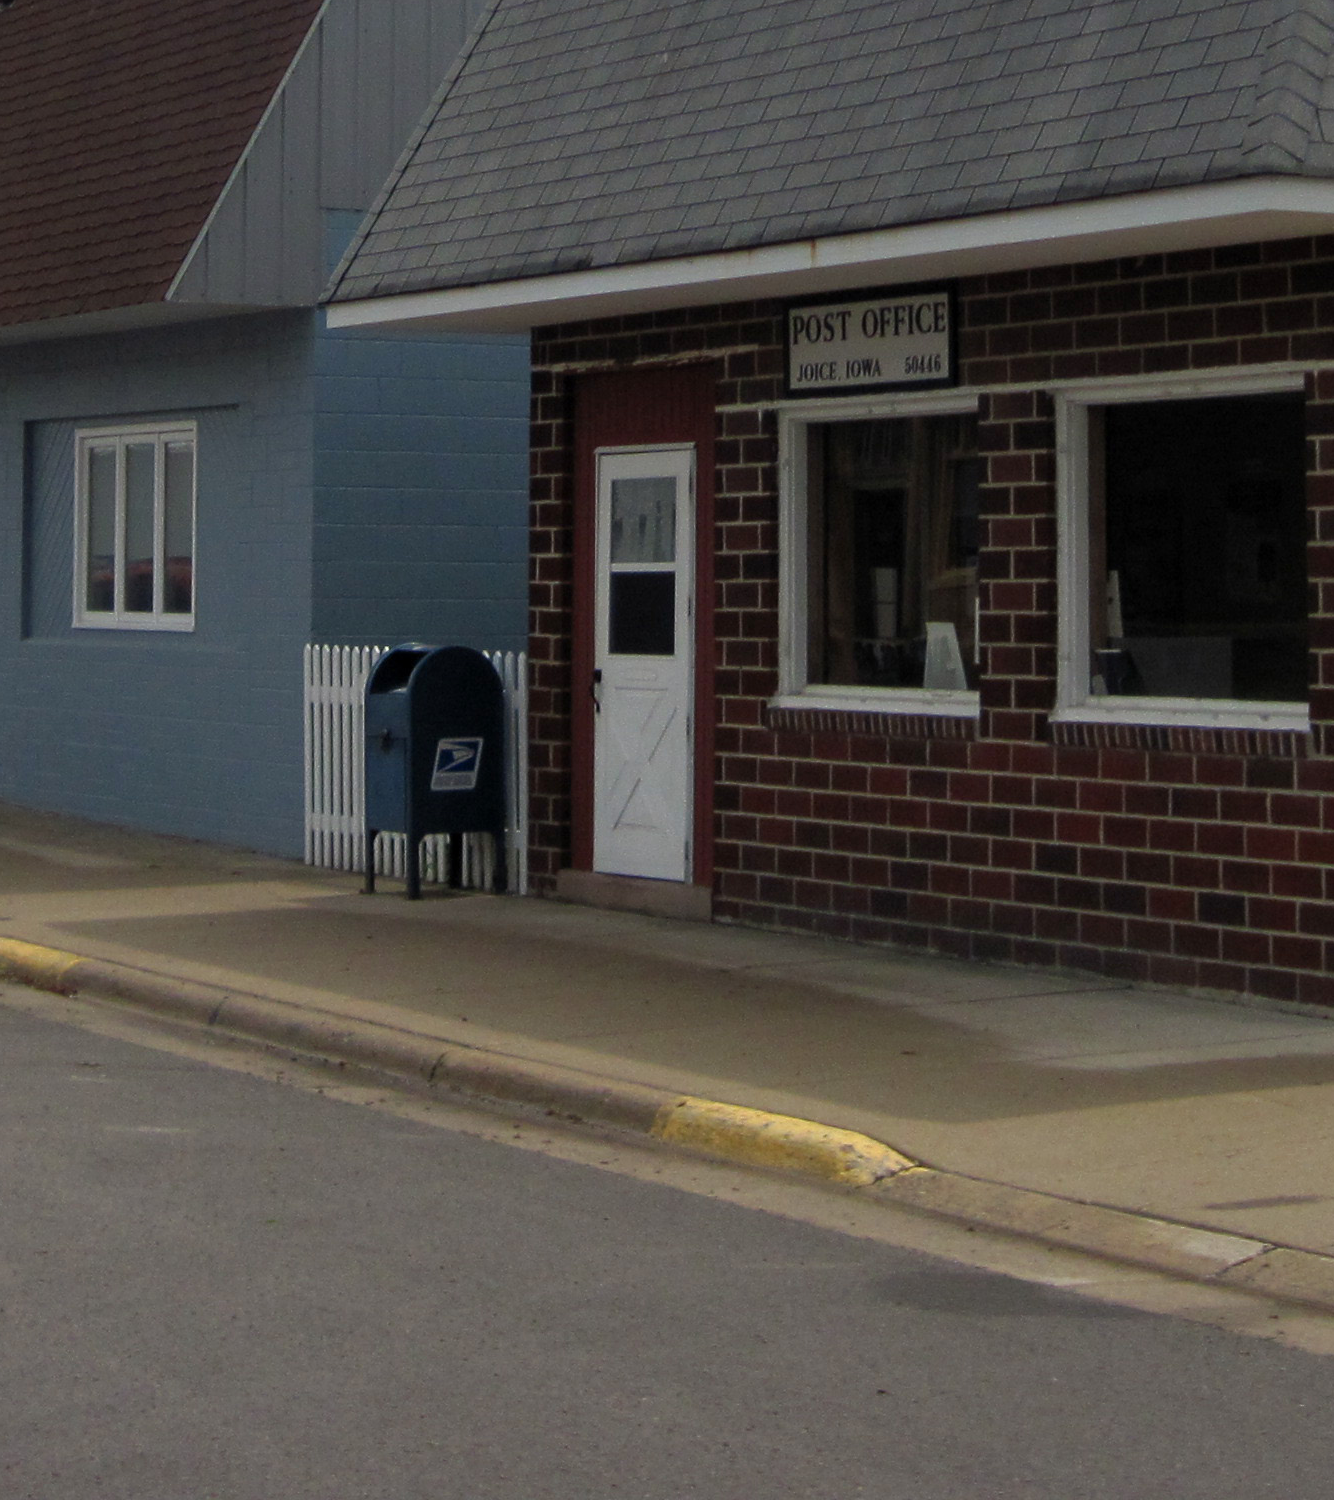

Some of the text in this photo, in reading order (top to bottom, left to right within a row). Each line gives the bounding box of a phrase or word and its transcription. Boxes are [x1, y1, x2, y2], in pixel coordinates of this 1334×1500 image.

[792, 301, 946, 345] POST OFFICE
[797, 353, 942, 383] JOICE, IOWA 50446
